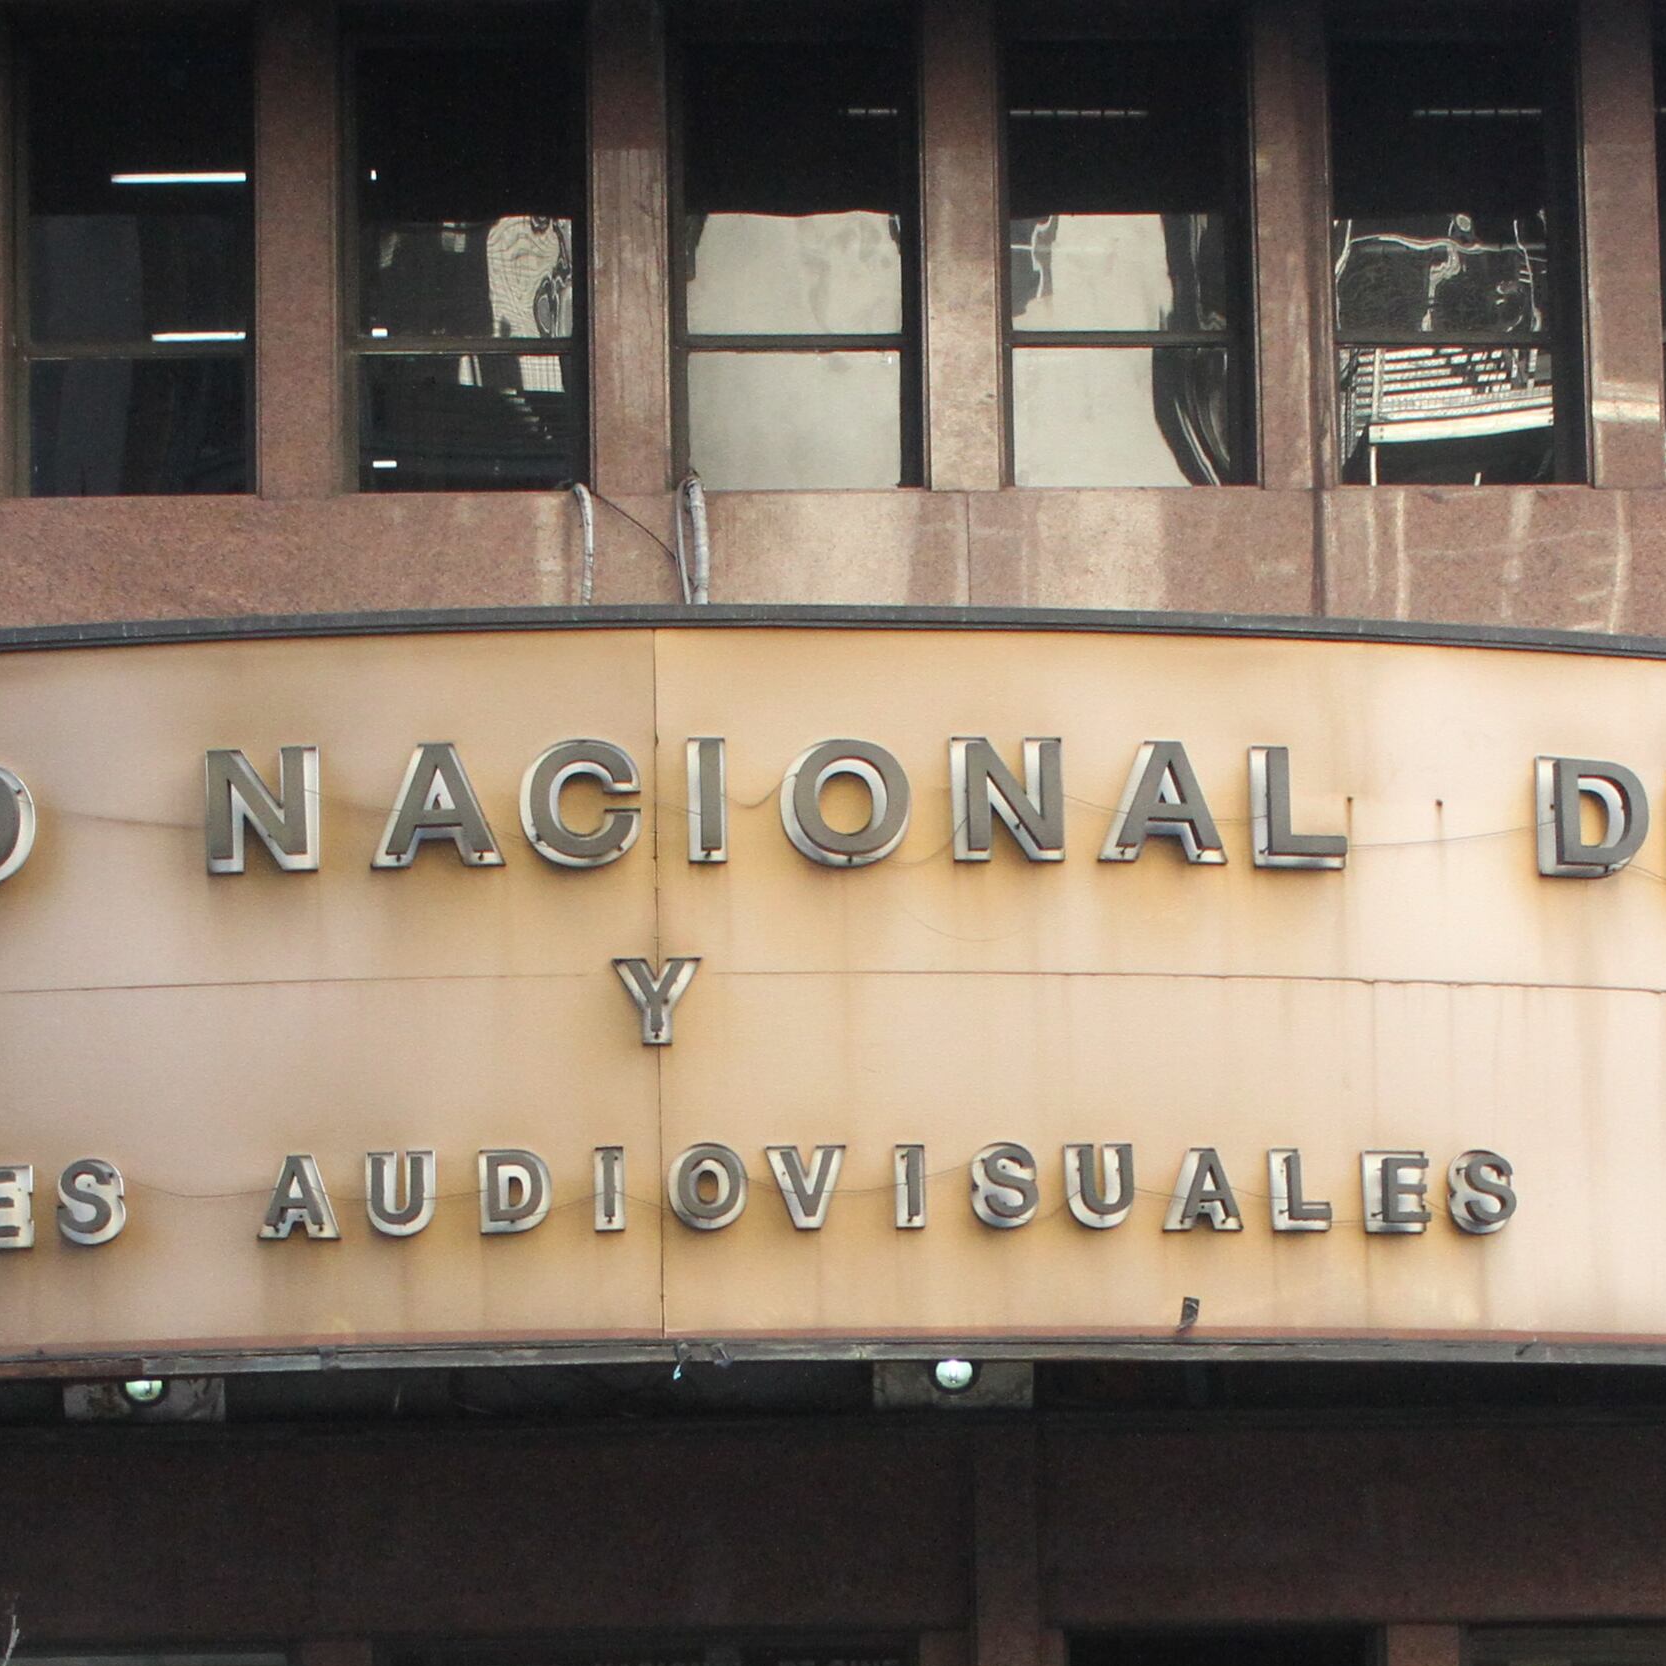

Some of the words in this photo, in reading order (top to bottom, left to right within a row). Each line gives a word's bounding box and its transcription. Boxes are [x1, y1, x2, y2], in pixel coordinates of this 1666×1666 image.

[204, 736, 1348, 875] NACIONAL
[613, 956, 703, 1048] Y
[258, 1141, 1519, 1242] AUDIOVISUALES
